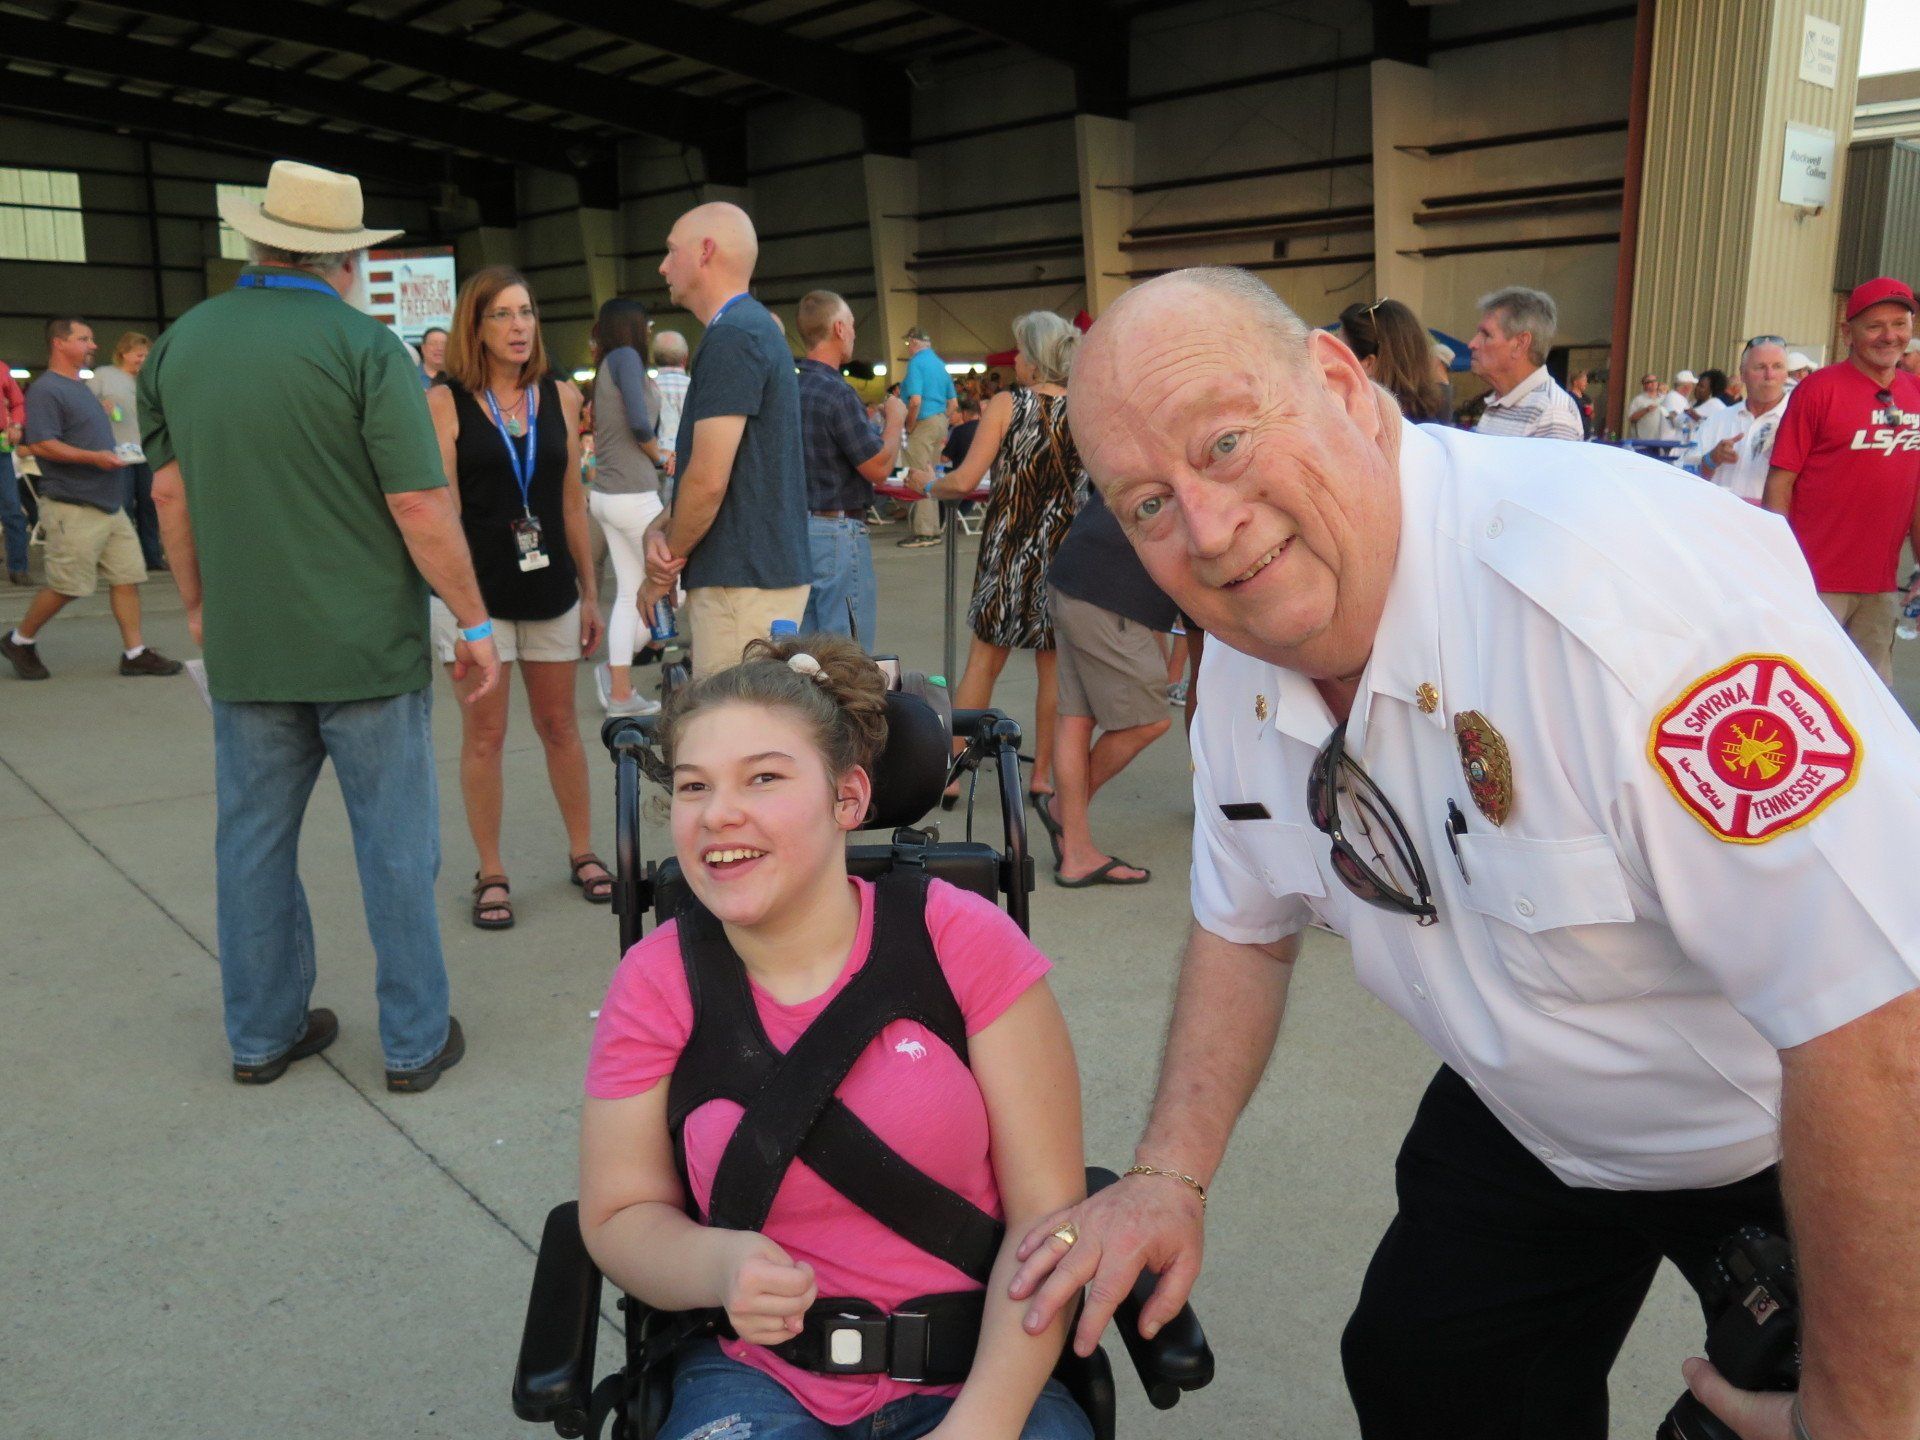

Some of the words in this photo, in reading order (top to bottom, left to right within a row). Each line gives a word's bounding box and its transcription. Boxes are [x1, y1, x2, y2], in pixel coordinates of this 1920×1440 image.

[400, 297, 452, 317] FREEDOM
[1871, 409, 1920, 430] Hley
[1684, 682, 1750, 733] SMYRNA
[1777, 689, 1825, 742] DEPT
[1678, 757, 1725, 810] FIRE
[1752, 765, 1826, 820] TENNESSEE
